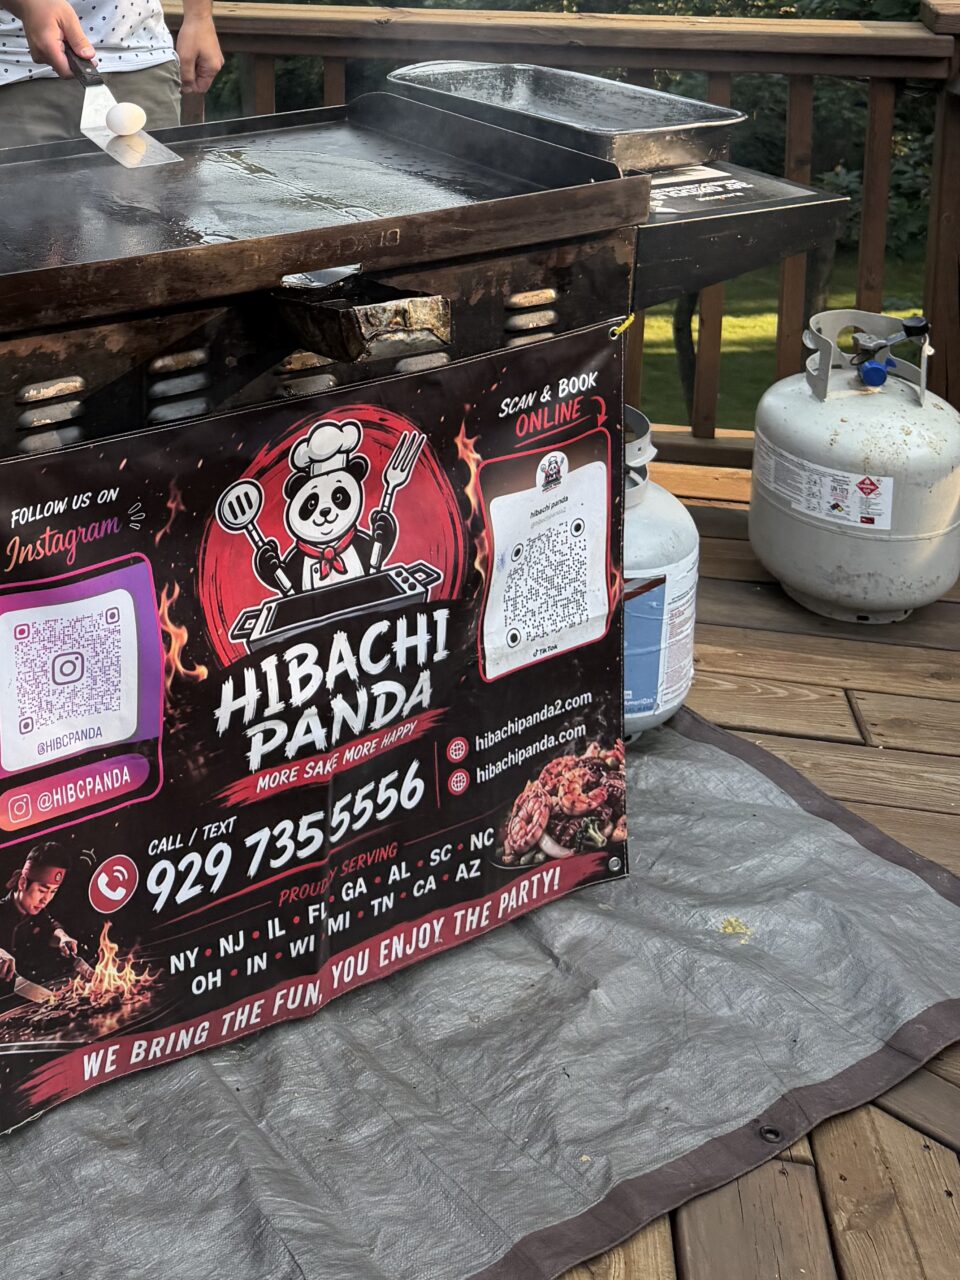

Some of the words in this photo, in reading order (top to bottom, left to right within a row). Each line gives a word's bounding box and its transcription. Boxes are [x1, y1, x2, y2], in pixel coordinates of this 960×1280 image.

[498, 390, 537, 418] SCAN
[540, 384, 551, 402] &
[558, 371, 598, 398] BOOK
[515, 395, 584, 438] ONLINE
[10, 497, 68, 528] FOLLOW
[71, 492, 93, 510] US
[97, 487, 119, 504] ON
[4, 516, 121, 572] Instagram
[213, 608, 450, 737] HIBACHI
[37, 726, 103, 756] @HIBCPANDA
[243, 669, 433, 774] PANDA
[475, 692, 593, 752] hibachipanda2.com
[256, 766, 300, 793] MORE
[303, 752, 340, 778] SAKE
[342, 738, 379, 765] MORE
[381, 720, 418, 749] HAPPY
[476, 724, 586, 784] hibachipanda.com
[37, 765, 131, 812] @HIBCPANDA
[148, 833, 184, 856] CALL
[202, 815, 238, 841] TEXT
[340, 841, 398, 877] SERVING
[146, 841, 232, 914] 929
[170, 946, 199, 974] NY
[219, 930, 245, 957] NJ
[267, 917, 286, 940] IL
[341, 877, 367, 902] GA
[388, 861, 411, 885] AL
[430, 844, 453, 867] SC
[470, 828, 494, 852] NC
[191, 968, 222, 995] OH
[246, 952, 267, 976] IN
[289, 934, 315, 958] WI
[327, 911, 350, 936] MI
[371, 892, 394, 917] TN
[413, 875, 437, 897] CA
[455, 859, 481, 882] AZ
[83, 1044, 120, 1081] WE
[130, 1021, 210, 1065] BRING
[220, 999, 265, 1036] THE
[272, 979, 323, 1016] FUN,
[331, 948, 369, 989] YOU
[379, 917, 444, 968] ENJOY
[454, 901, 492, 936] THE
[497, 866, 561, 919] PARTY!
